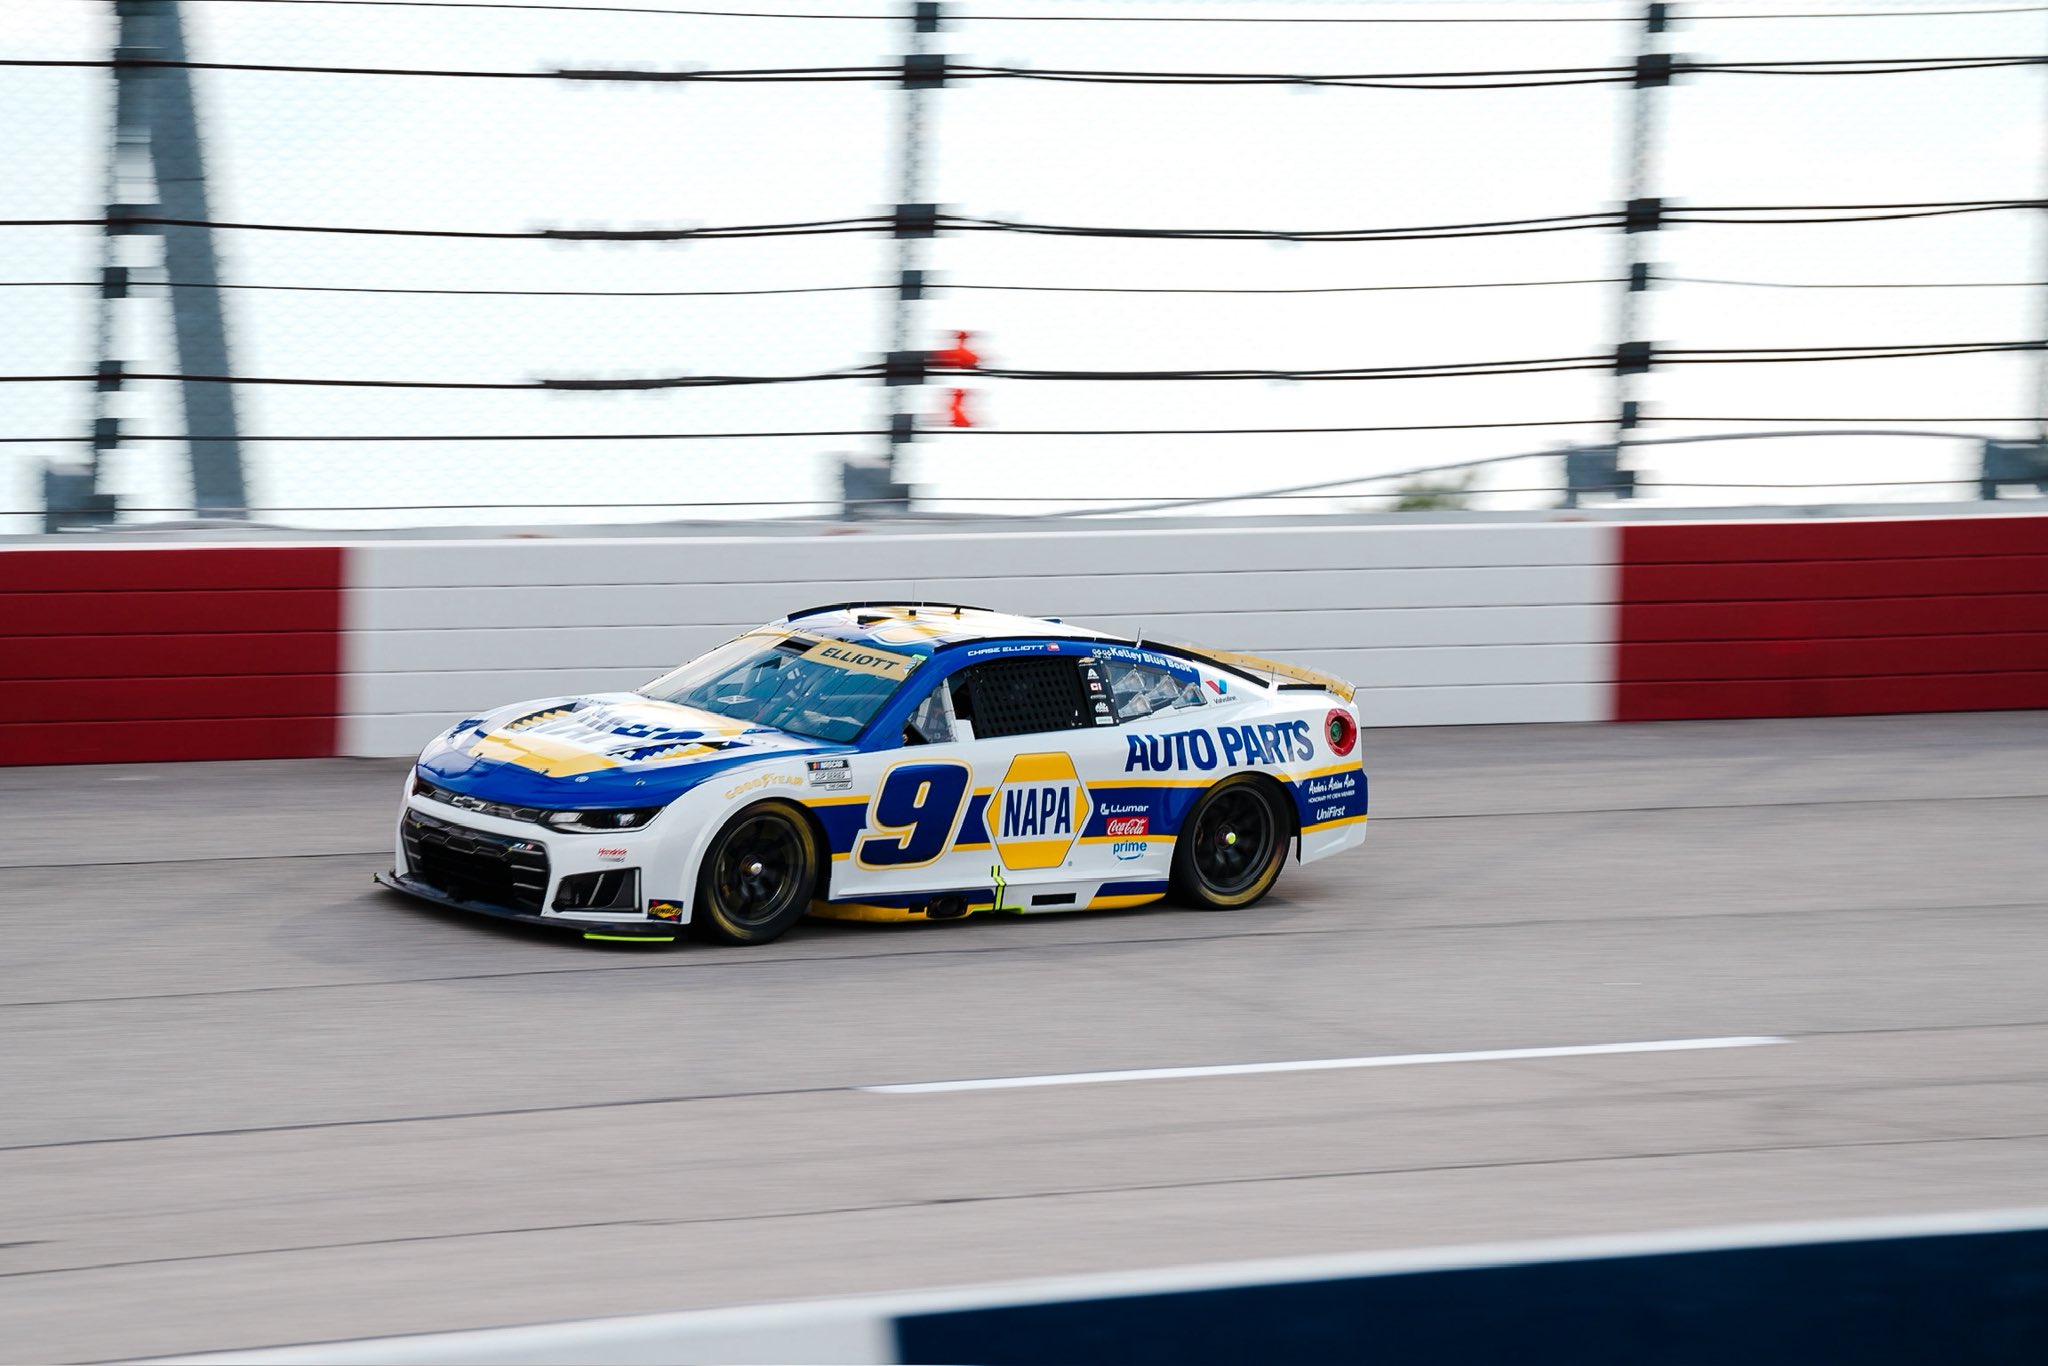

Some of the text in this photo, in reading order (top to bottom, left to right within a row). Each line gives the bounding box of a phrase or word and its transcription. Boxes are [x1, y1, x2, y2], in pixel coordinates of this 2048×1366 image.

[820, 647, 900, 671] ELLIOTT
[968, 647, 1000, 656] CHASE
[1110, 647, 1142, 663] Kelley
[1142, 653, 1166, 666] Blue
[1167, 659, 1192, 673] Book
[1124, 719, 1314, 772] AUTO PARTS
[821, 760, 844, 770] NASCAR
[724, 772, 804, 799] GOODYEAR
[814, 771, 846, 781] CUP SERIES
[857, 760, 971, 869] 9
[1003, 786, 1071, 837] NAPA
[1316, 805, 1345, 820] UniFirst
[1112, 840, 1148, 855] prime
[648, 906, 683, 917] SUNOCO
